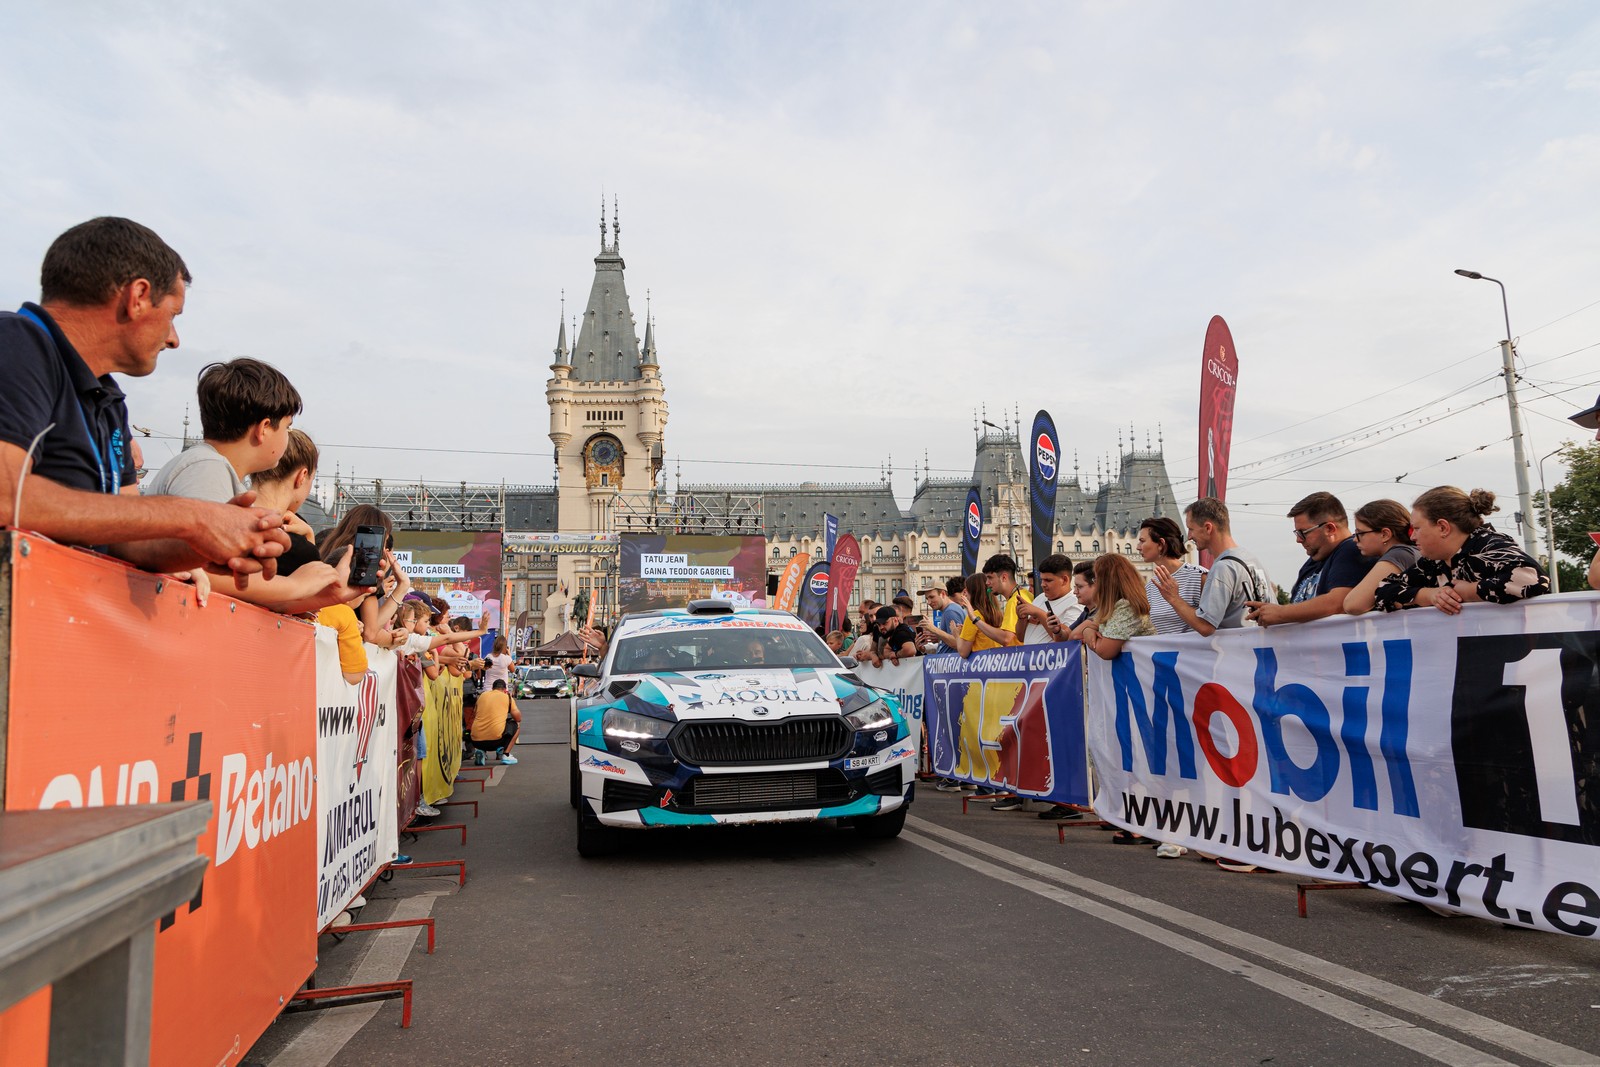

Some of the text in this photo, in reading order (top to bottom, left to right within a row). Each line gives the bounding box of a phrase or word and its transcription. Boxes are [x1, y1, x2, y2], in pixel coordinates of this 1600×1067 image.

[590, 544, 617, 553] 2024
[392, 553, 408, 561] AN
[644, 555, 684, 563] TATU JEAN
[836, 555, 858, 566] CRICOVA
[401, 566, 461, 574] ODOR GABRIEL
[644, 567, 731, 575] GAINA TEODOR GABRIEL
[780, 563, 800, 610] tano
[970, 651, 1026, 673] CONSILIUL
[1029, 647, 1069, 671] LOCAL
[717, 689, 832, 704] AQUILA
[1111, 639, 1580, 826] Mobil 1
[215, 752, 314, 867] Betano
[1122, 790, 1600, 938] www.lubexpert.e
